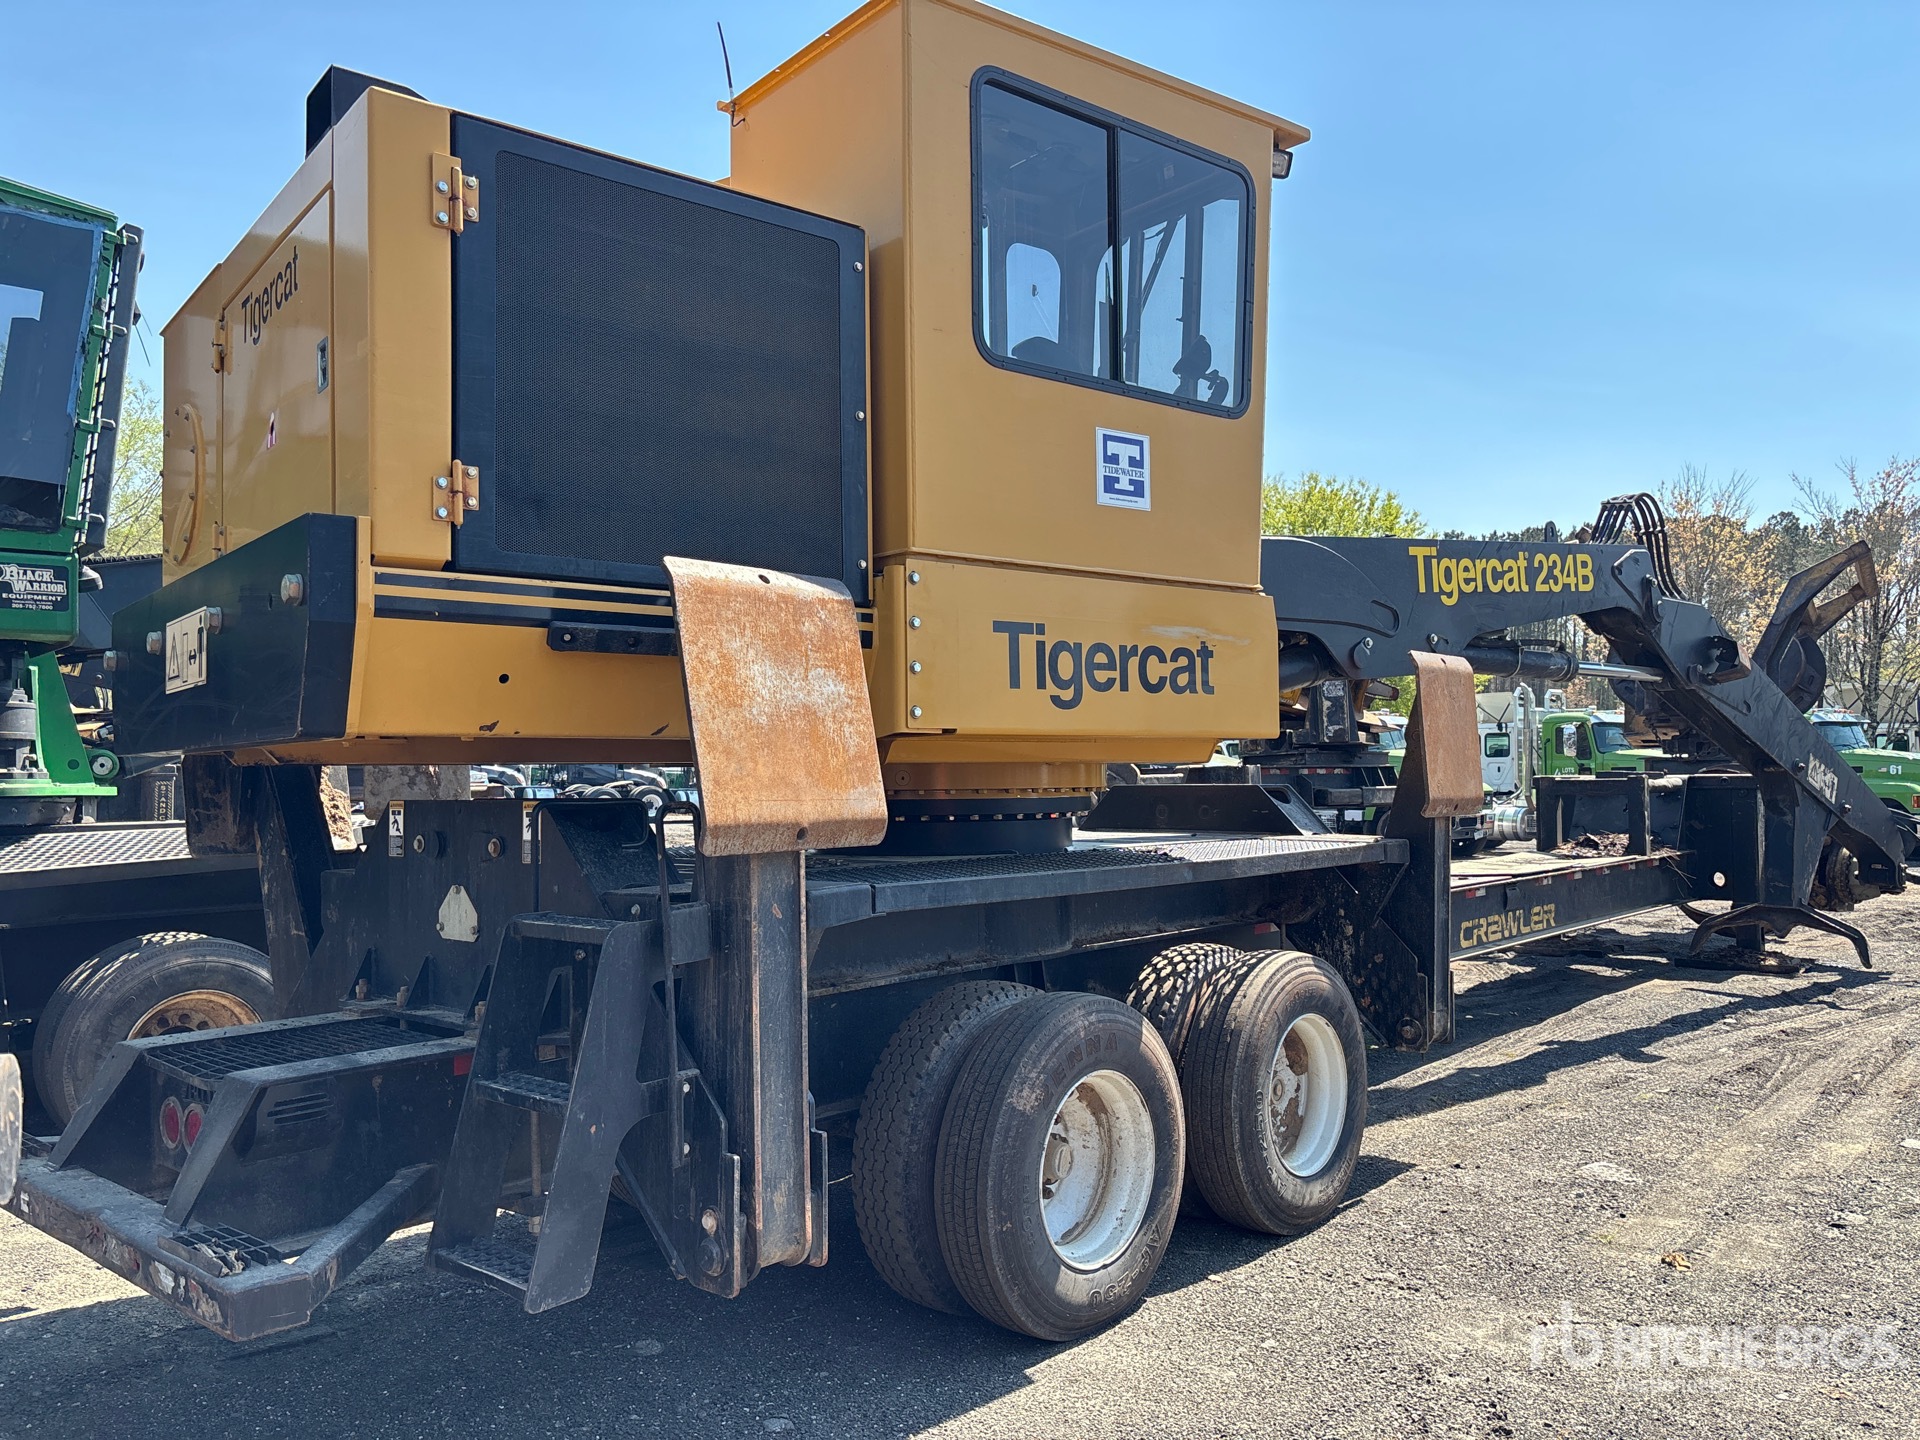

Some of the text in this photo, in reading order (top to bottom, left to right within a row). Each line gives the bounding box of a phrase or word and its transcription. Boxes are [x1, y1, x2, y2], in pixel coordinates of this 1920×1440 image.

[241, 245, 298, 346] Tigercat
[1103, 465, 1144, 478] TIDEWATER
[4, 566, 52, 581] BLACK
[1408, 546, 1595, 606] Tigercat 234B
[14, 581, 64, 592] WARRIOR
[2, 593, 62, 602] EQUIPMENT
[992, 620, 1215, 710] Tigercat
[1888, 764, 1902, 775] 61
[1460, 903, 1556, 949] CRAWLER
